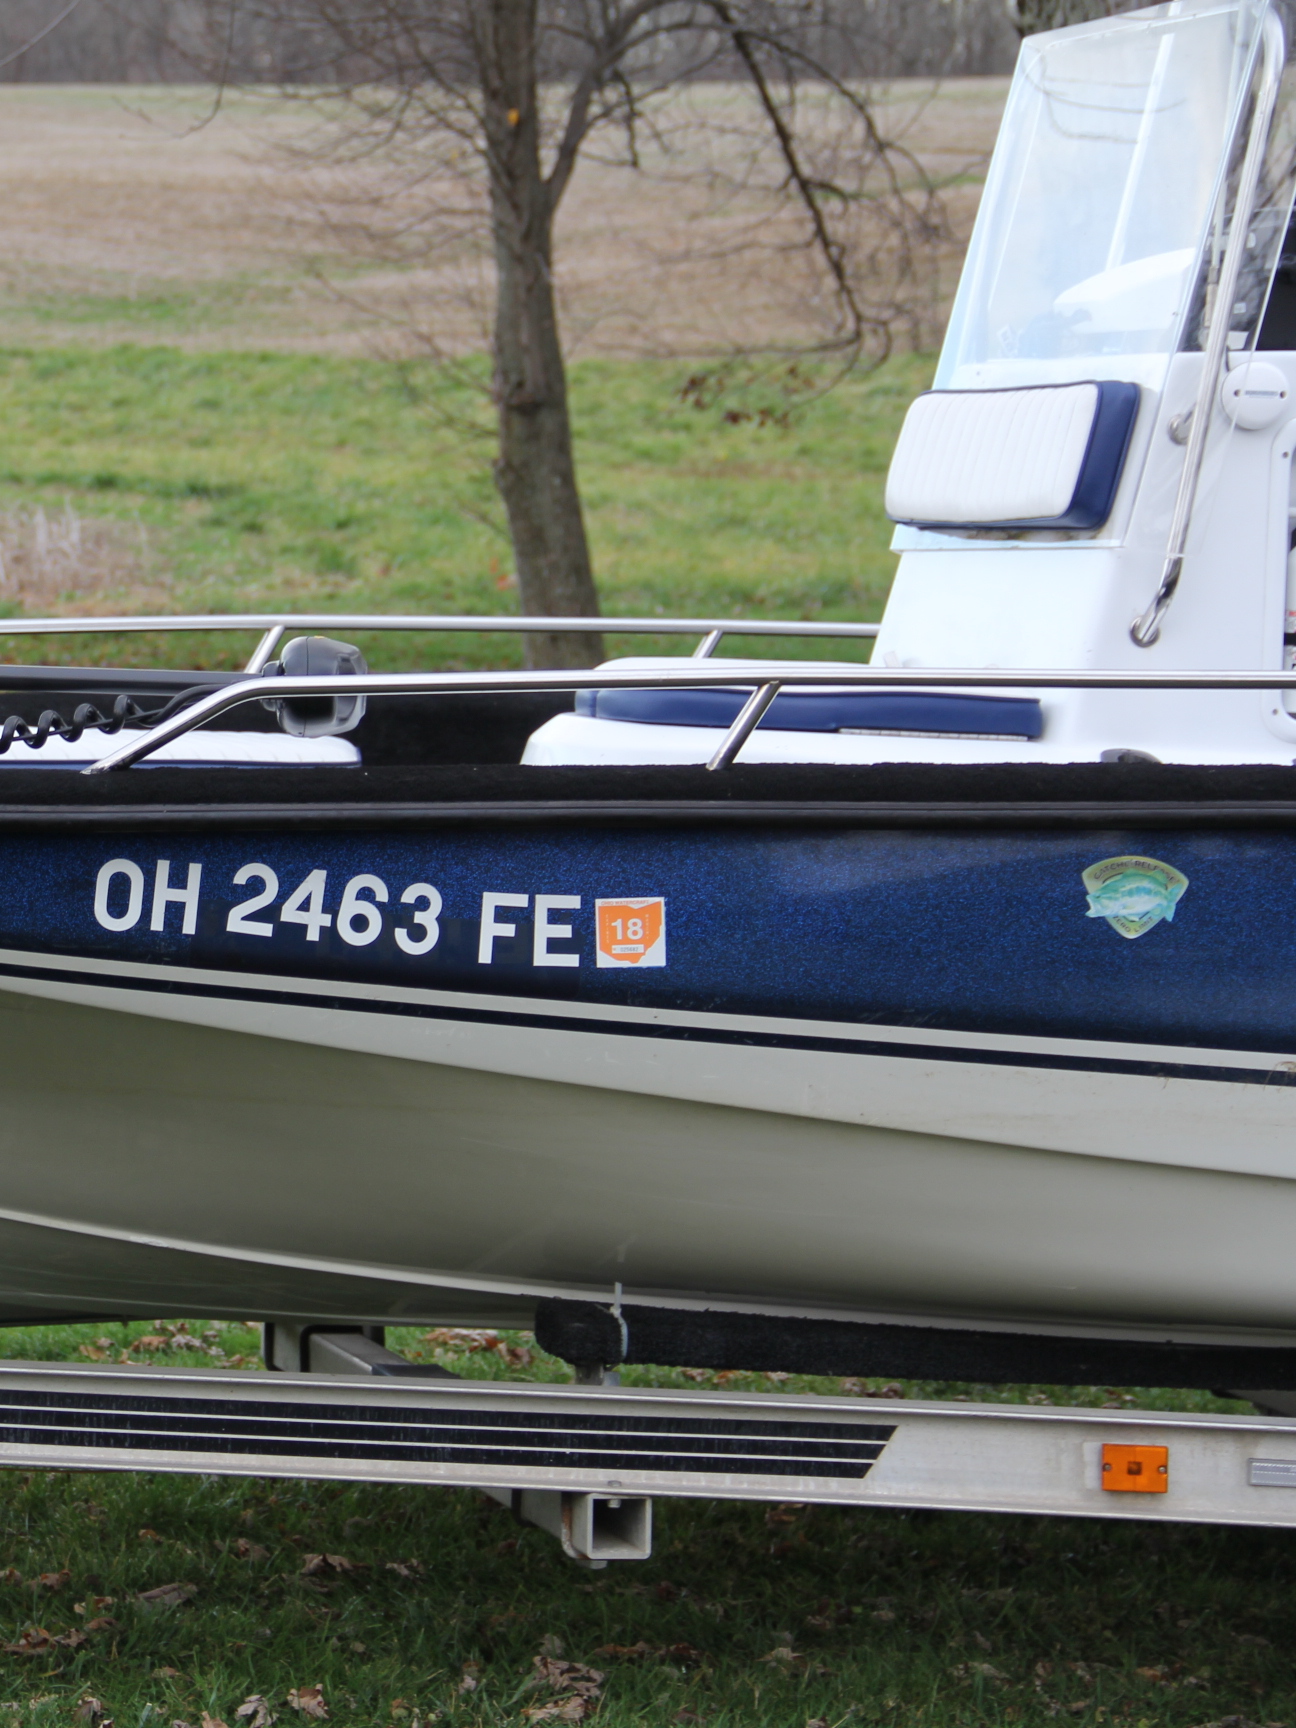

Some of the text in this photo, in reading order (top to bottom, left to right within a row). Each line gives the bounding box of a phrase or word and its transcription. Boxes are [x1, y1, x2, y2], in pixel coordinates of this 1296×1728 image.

[94, 858, 581, 967] OH 2463 FE
[611, 918, 644, 940] 18
